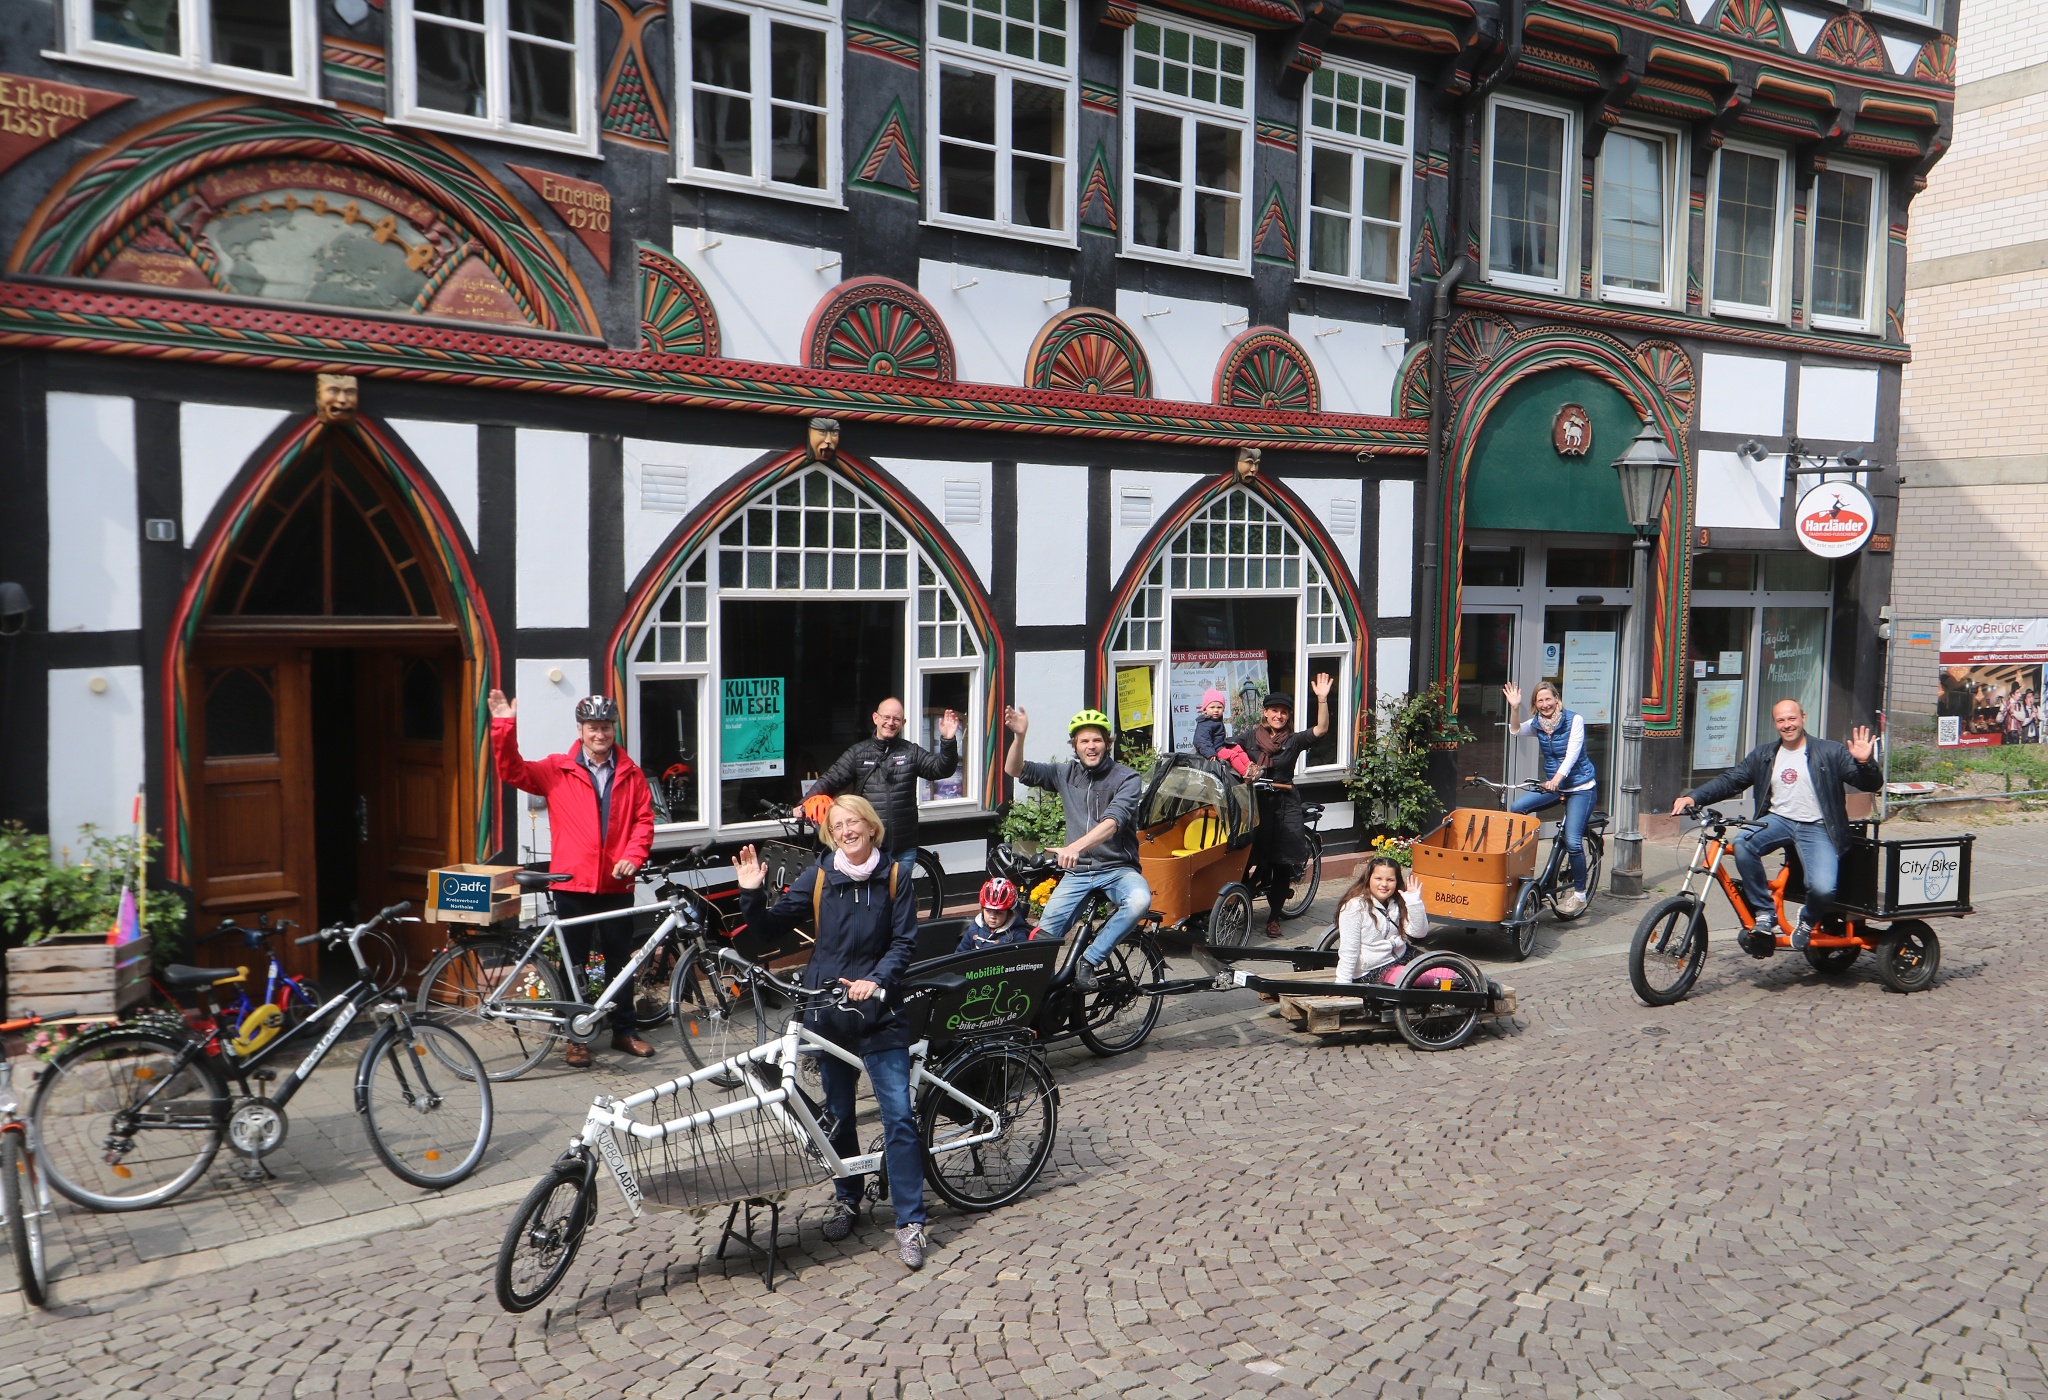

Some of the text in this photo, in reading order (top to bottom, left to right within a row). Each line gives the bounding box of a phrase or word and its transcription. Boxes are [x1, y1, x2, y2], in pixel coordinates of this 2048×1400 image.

[0, 77, 88, 119] Erbaut
[0, 108, 59, 138] 1557
[543, 177, 611, 212] Erneuert
[567, 207, 610, 233] 1910
[157, 522, 165, 539] 1
[1805, 519, 1863, 532] Harzländer
[1700, 529, 1708, 544] 3
[1171, 653, 1186, 661] WIR
[1187, 652, 1197, 660] für
[1209, 651, 1239, 660] blühendes
[1240, 651, 1264, 659] Einbeck!
[725, 680, 780, 698] KULTUR
[725, 697, 780, 715] IM ESEL
[1173, 705, 1189, 713] KFE
[1900, 859, 1957, 875] City Bike
[460, 881, 487, 892] adfc
[1435, 891, 1470, 906] BABBOE
[965, 965, 1005, 981] Mobilität
[1016, 962, 1044, 972] Göttingen
[946, 1011, 1018, 1031] e-bike-family.de
[597, 1129, 640, 1200] TURBOLADER
